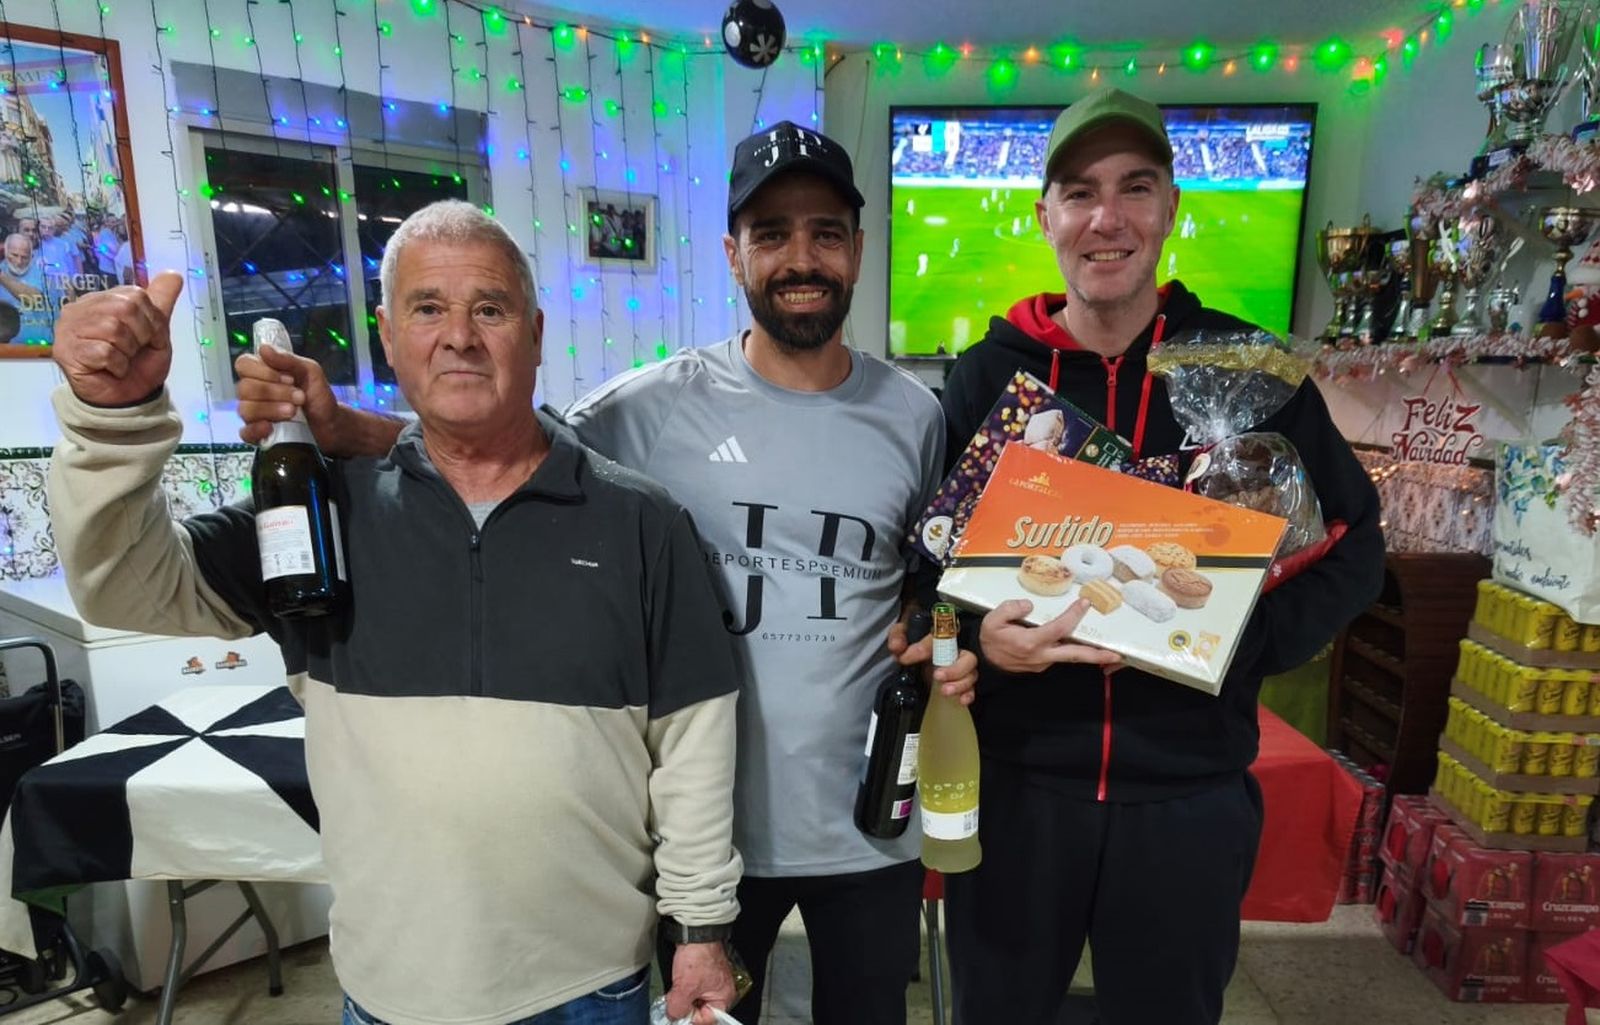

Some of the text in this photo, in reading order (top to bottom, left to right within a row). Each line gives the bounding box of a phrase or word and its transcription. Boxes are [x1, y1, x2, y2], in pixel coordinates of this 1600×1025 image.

[1401, 395, 1480, 433] Feliz
[1392, 432, 1484, 466] Navidad
[1007, 515, 1114, 548] Surtido
[1468, 898, 1526, 911] campo
